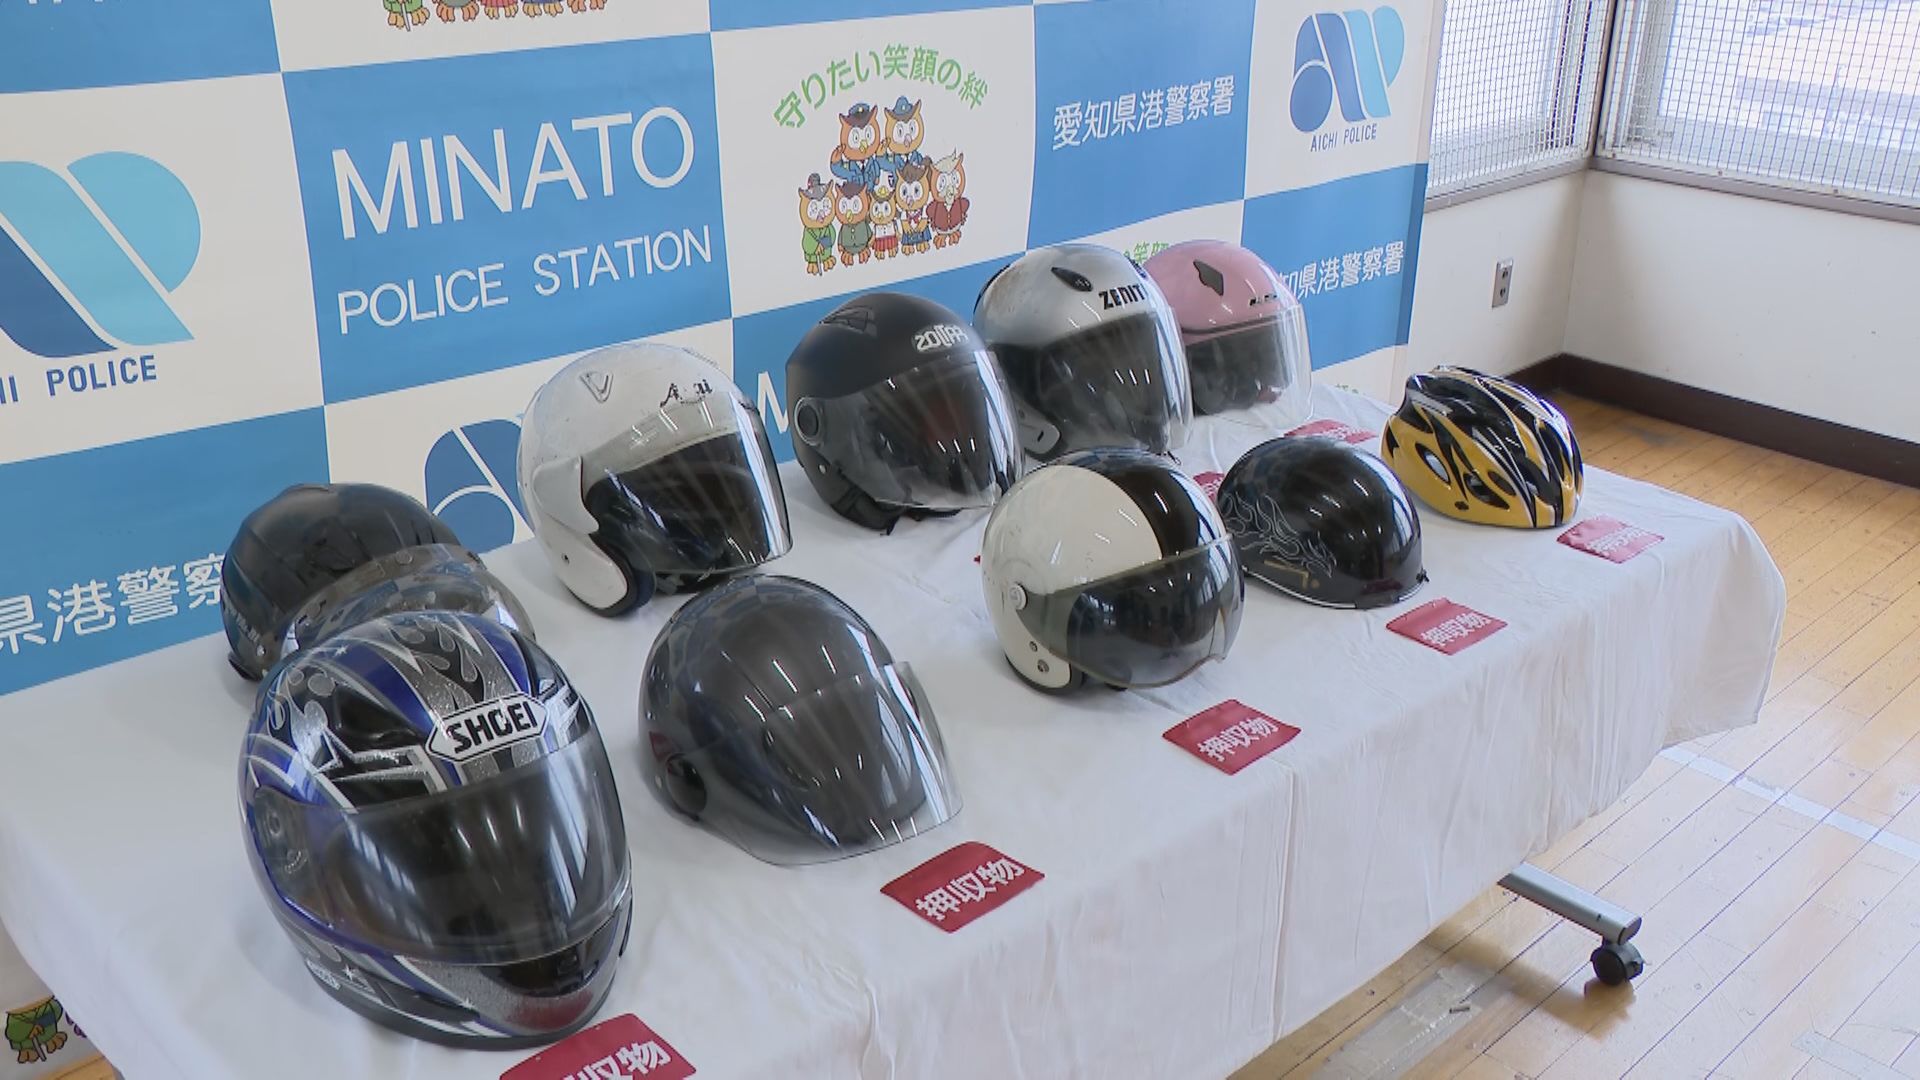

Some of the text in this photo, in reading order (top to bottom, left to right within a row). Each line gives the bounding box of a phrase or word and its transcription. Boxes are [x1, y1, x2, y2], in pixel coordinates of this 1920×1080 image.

[773, 43, 989, 128] 守りたい笑顔の絆
[1052, 74, 1235, 151] 愛知県港警察署
[1310, 123, 1378, 153] AICHI POLICE
[331, 106, 695, 240] MINATO
[337, 224, 712, 335] POLICE STATION
[46, 354, 157, 397] POLICE
[446, 700, 538, 754] SHOEI
[1197, 717, 1279, 762] 押収物
[915, 857, 1026, 921] 押収物
[563, 1040, 671, 1080] 収物
